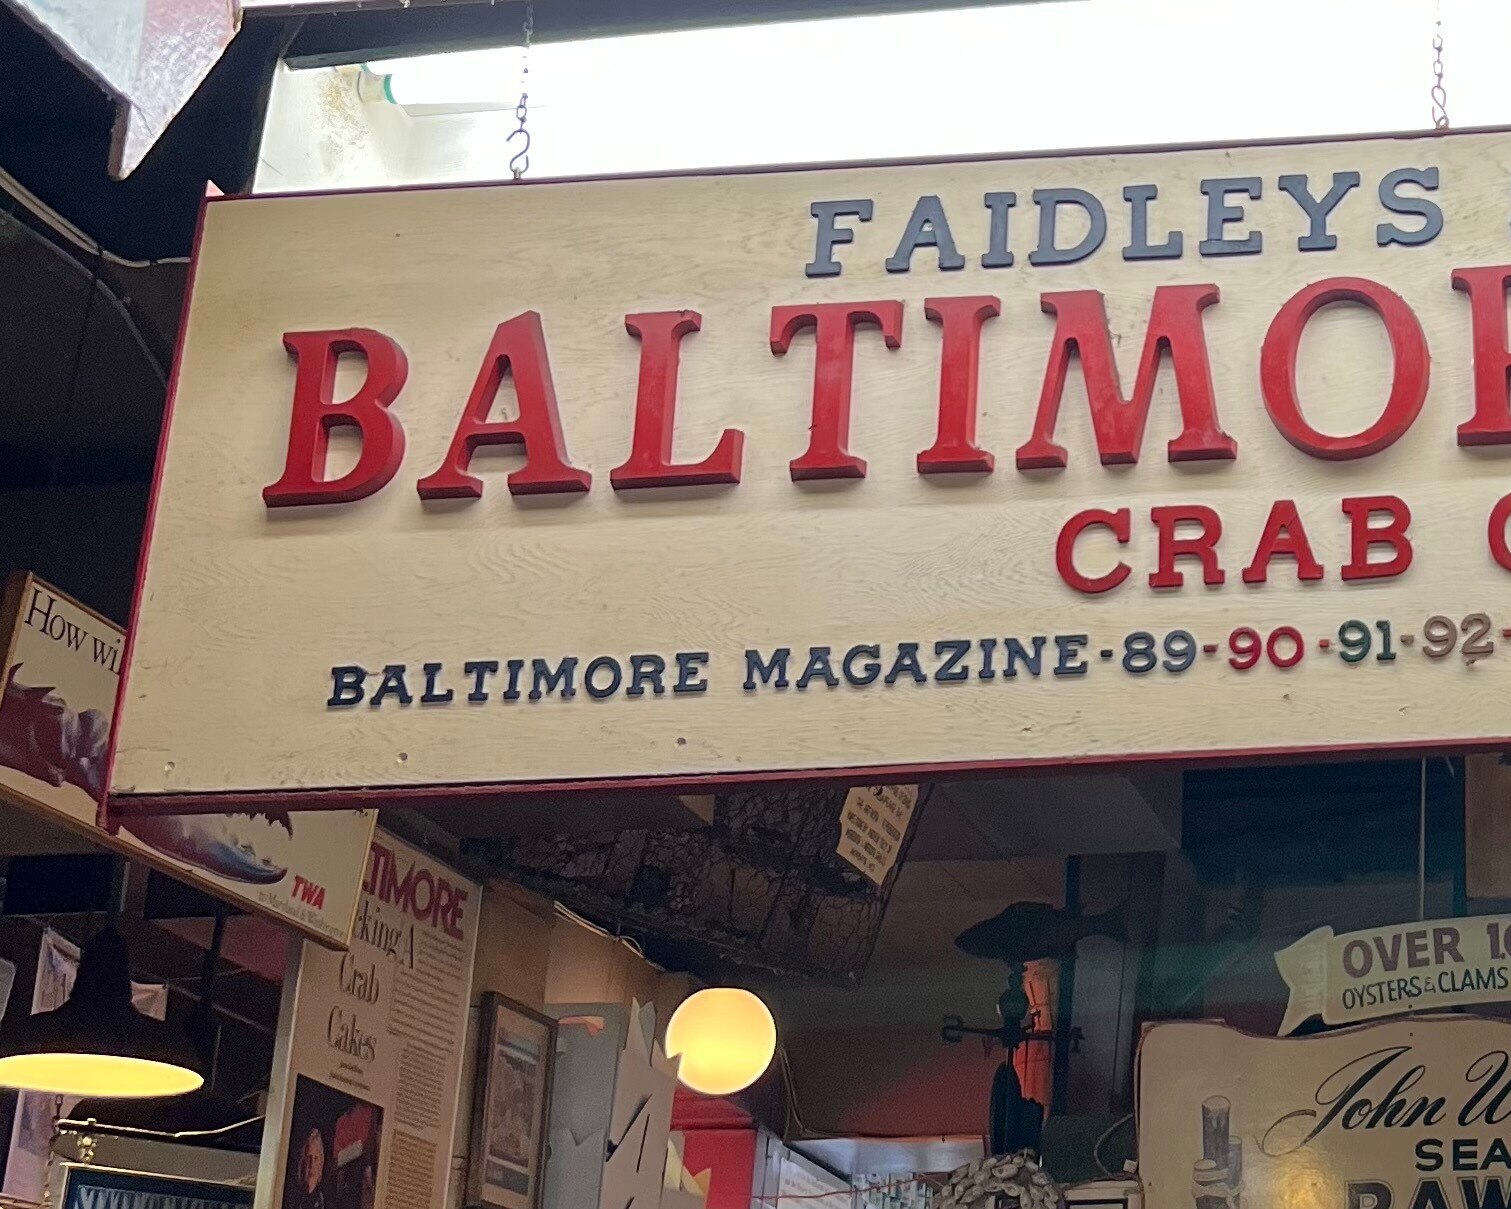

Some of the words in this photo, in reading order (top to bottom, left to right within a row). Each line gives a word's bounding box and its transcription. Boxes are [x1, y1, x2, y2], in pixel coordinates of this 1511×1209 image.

[805, 166, 1443, 277] FAIDLEYS
[1056, 495, 1412, 594] CRAB
[24, 587, 88, 651] How
[328, 651, 709, 707] BALTIMORE
[291, 874, 326, 911] TWA
[338, 953, 380, 1005] Crab
[1342, 926, 1464, 978] OVER
[326, 1005, 377, 1063] Cakes
[1256, 1046, 1446, 1157] John
